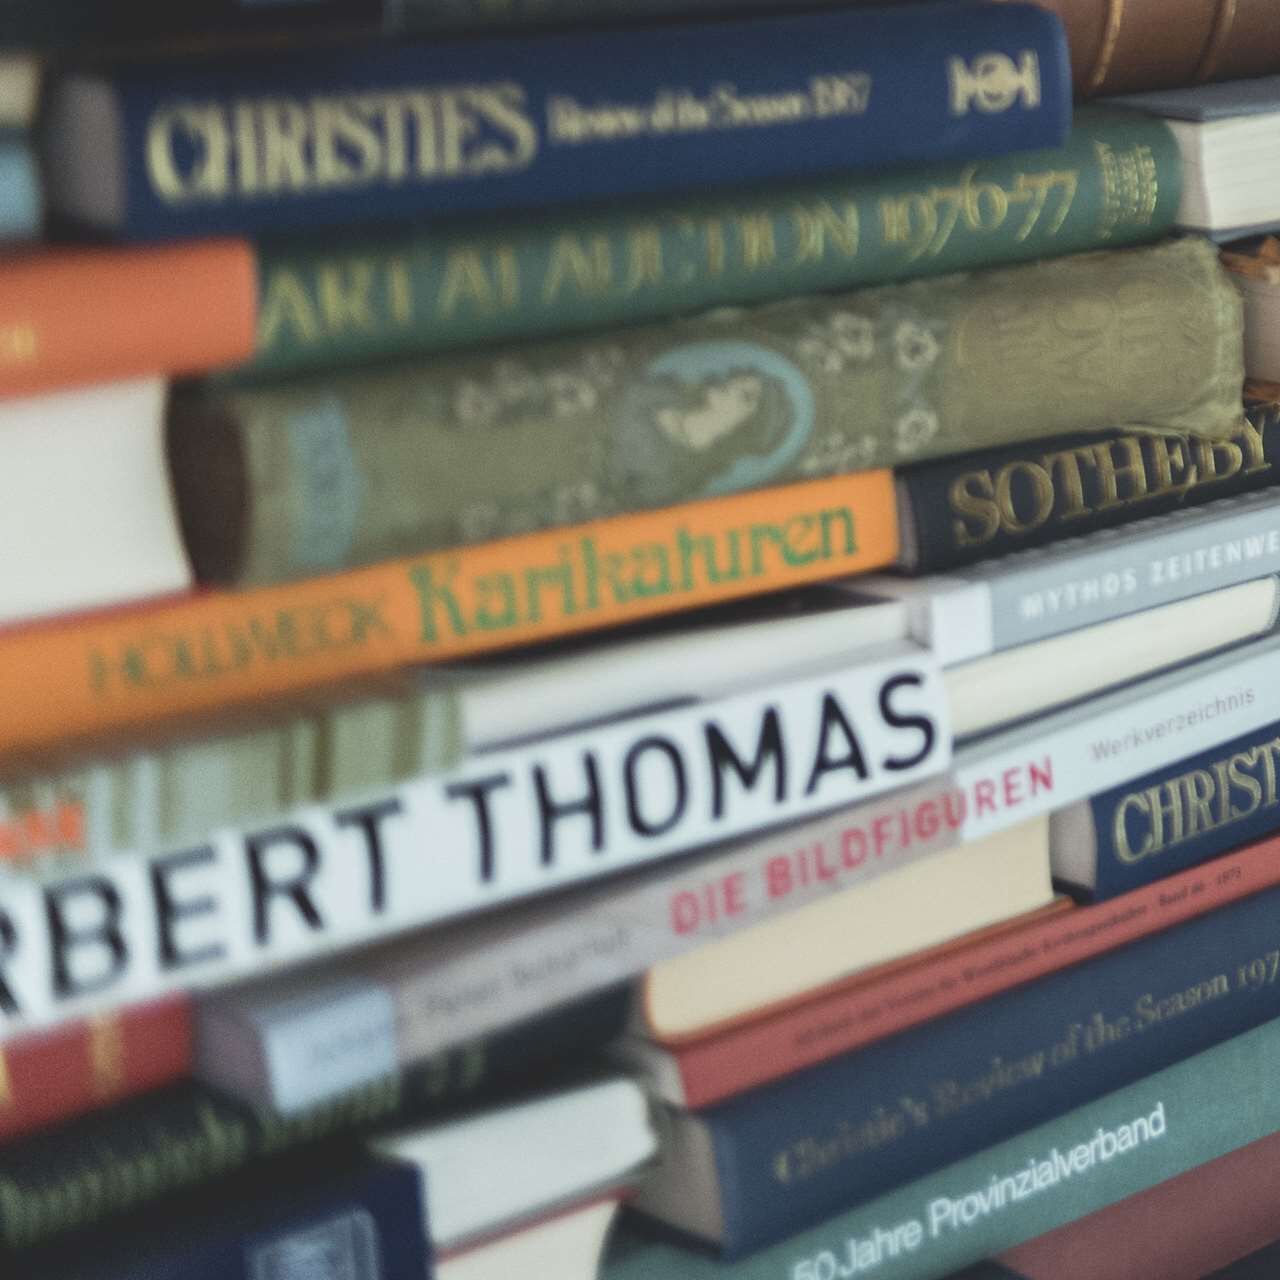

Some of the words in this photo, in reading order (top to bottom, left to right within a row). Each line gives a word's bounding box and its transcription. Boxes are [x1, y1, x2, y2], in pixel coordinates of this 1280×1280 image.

[408, 504, 859, 647] Karikaturen
[1020, 568, 1137, 619] MYTHOS
[0, 798, 407, 1018] BERT
[446, 672, 938, 884] THOMAS
[670, 872, 746, 936] DIE
[764, 757, 1055, 904] BILDFIGUREN
[1089, 686, 1257, 763] Werkverzeichnis
[1134, 970, 1229, 1030] Season
[840, 1220, 924, 1278] Jahre
[926, 1101, 1168, 1237] Provinzialverband
